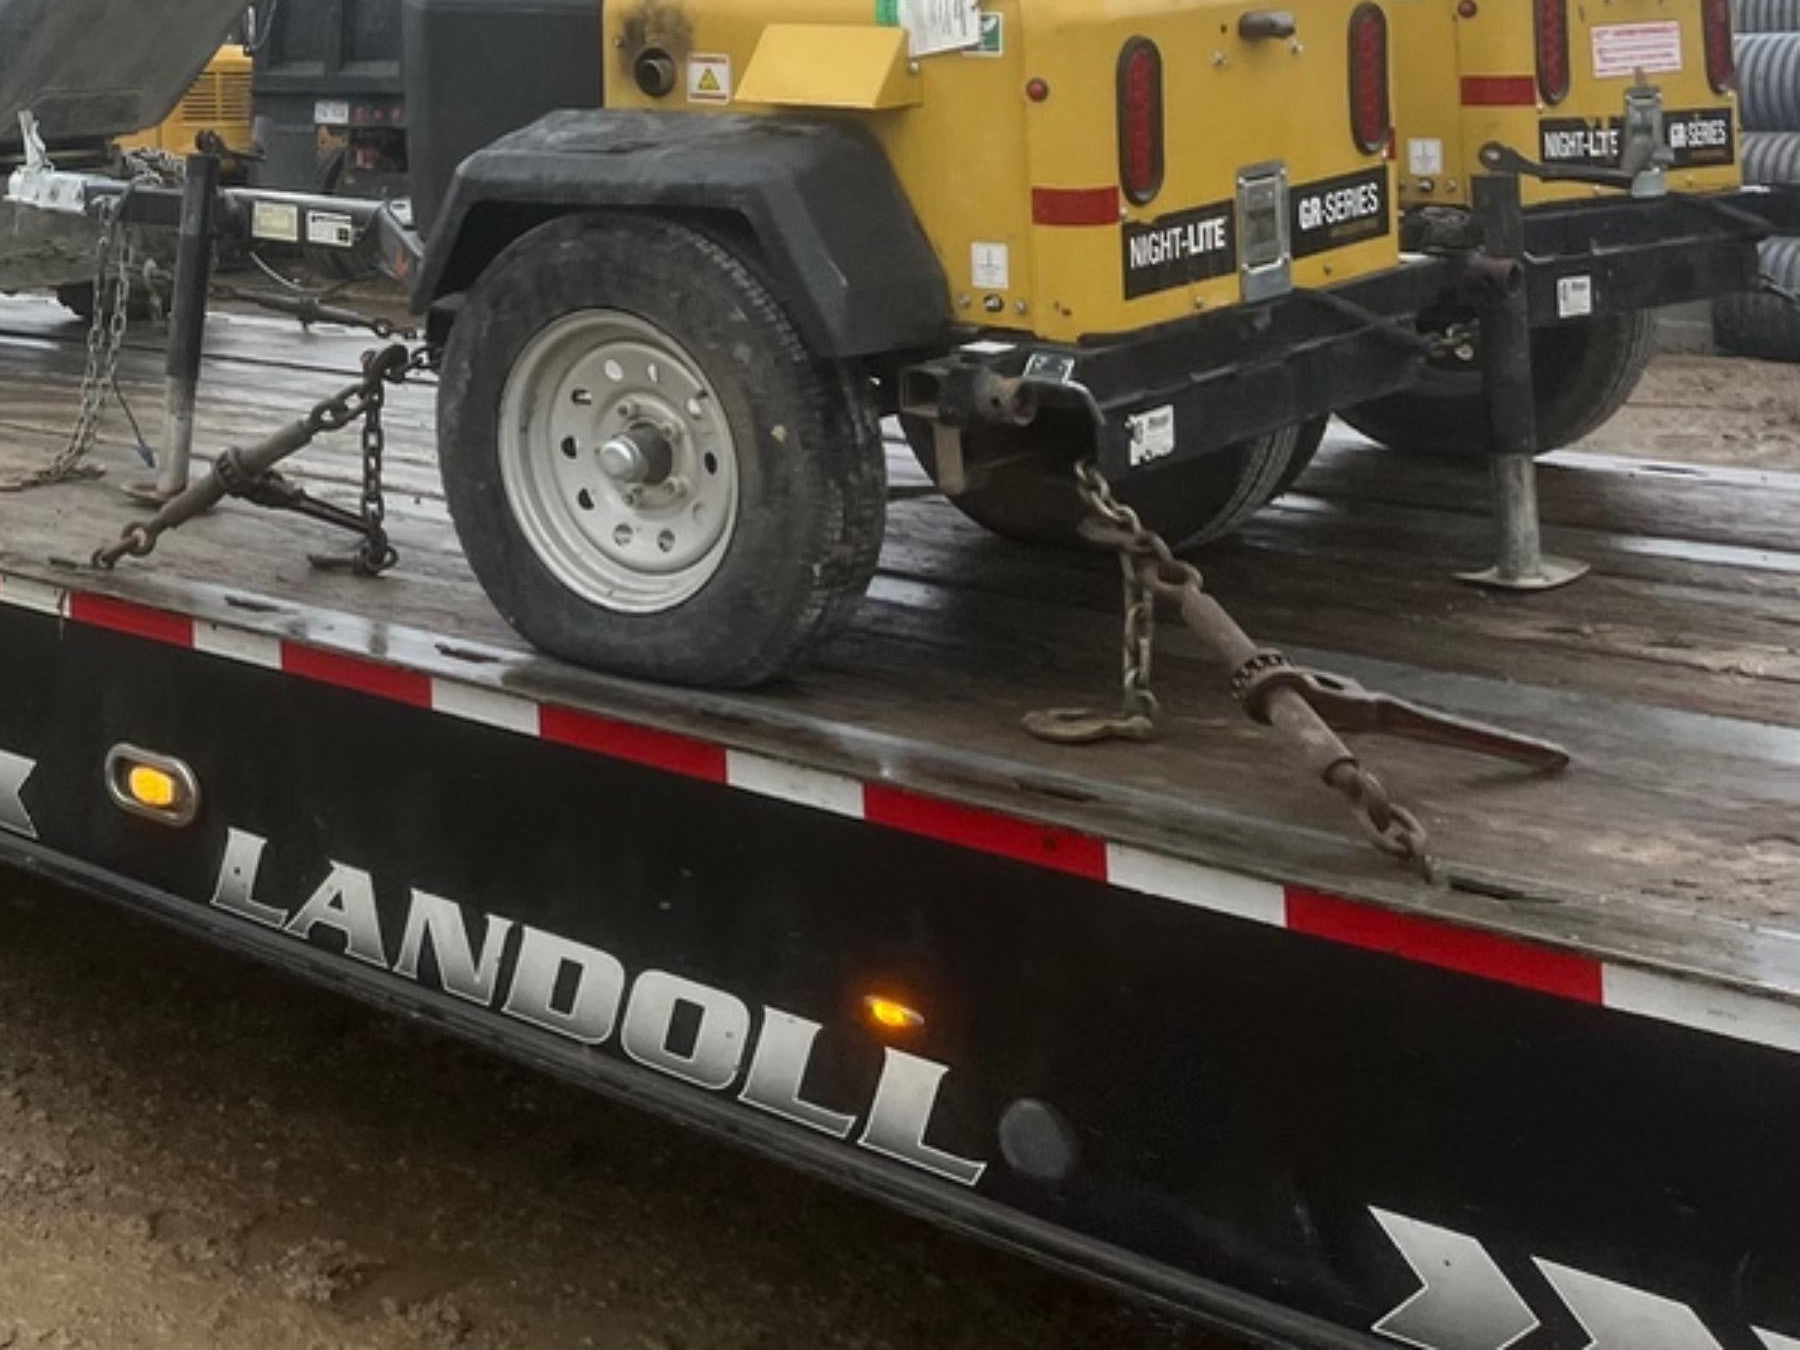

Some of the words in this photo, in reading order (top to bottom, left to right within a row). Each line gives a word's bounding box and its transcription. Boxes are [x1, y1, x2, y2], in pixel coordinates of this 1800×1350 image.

[1129, 215, 1228, 268] NIGHT-LITE
[1299, 182, 1379, 231] GR-SERIES
[209, 827, 987, 1188] LANDOLL
